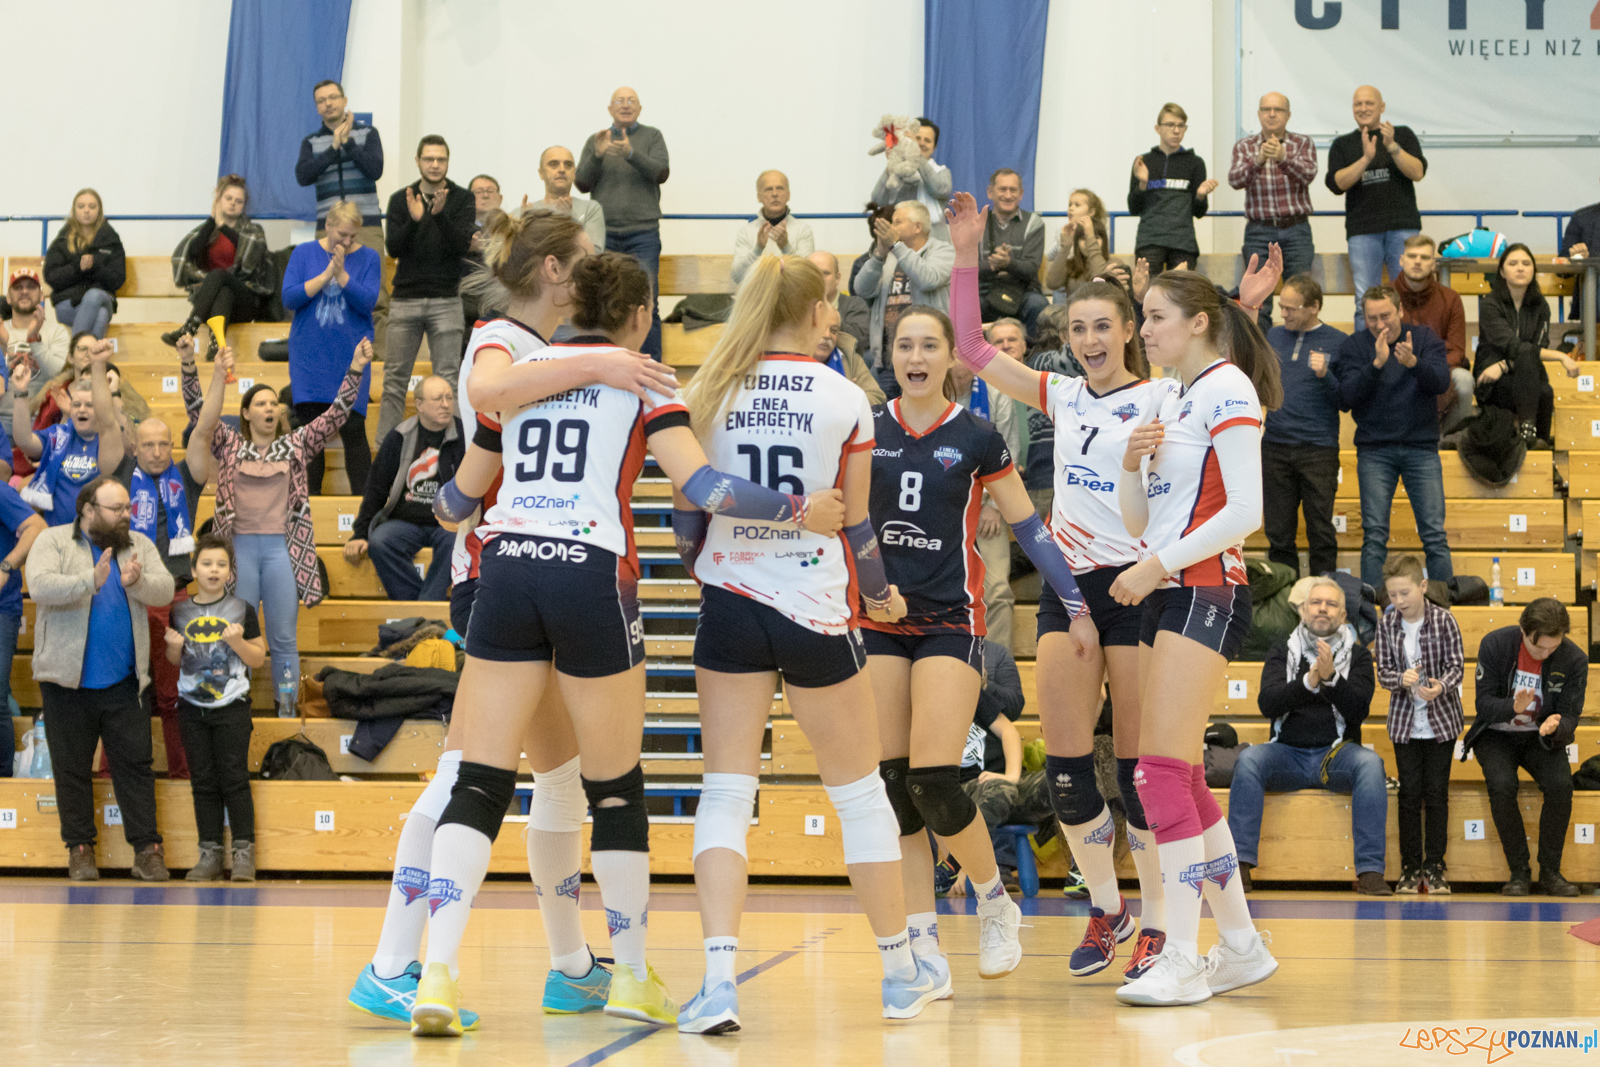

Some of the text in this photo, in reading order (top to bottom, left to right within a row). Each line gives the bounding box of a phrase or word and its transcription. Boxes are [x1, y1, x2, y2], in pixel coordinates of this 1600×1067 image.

[1448, 39, 1531, 60] WIĘCEJ
[1545, 37, 1582, 56] NIŻ
[165, 379, 175, 387] 14
[1581, 378, 1590, 386] 16
[753, 398, 789, 411] ENEA
[726, 411, 815, 434] ENERGETYK
[1080, 424, 1100, 456] 7
[515, 418, 590, 482] 99
[737, 444, 805, 497] 16
[1066, 472, 1115, 493] Enea
[898, 470, 924, 512] 8
[341, 517, 351, 526] 11
[882, 529, 942, 551] Enea
[1235, 683, 1241, 692] 4
[2, 811, 13, 822] 13
[108, 808, 119, 818] 12
[319, 814, 330, 824] 10
[811, 818, 818, 828] 8
[1471, 823, 1478, 833] 2
[1582, 827, 1588, 837] 1
